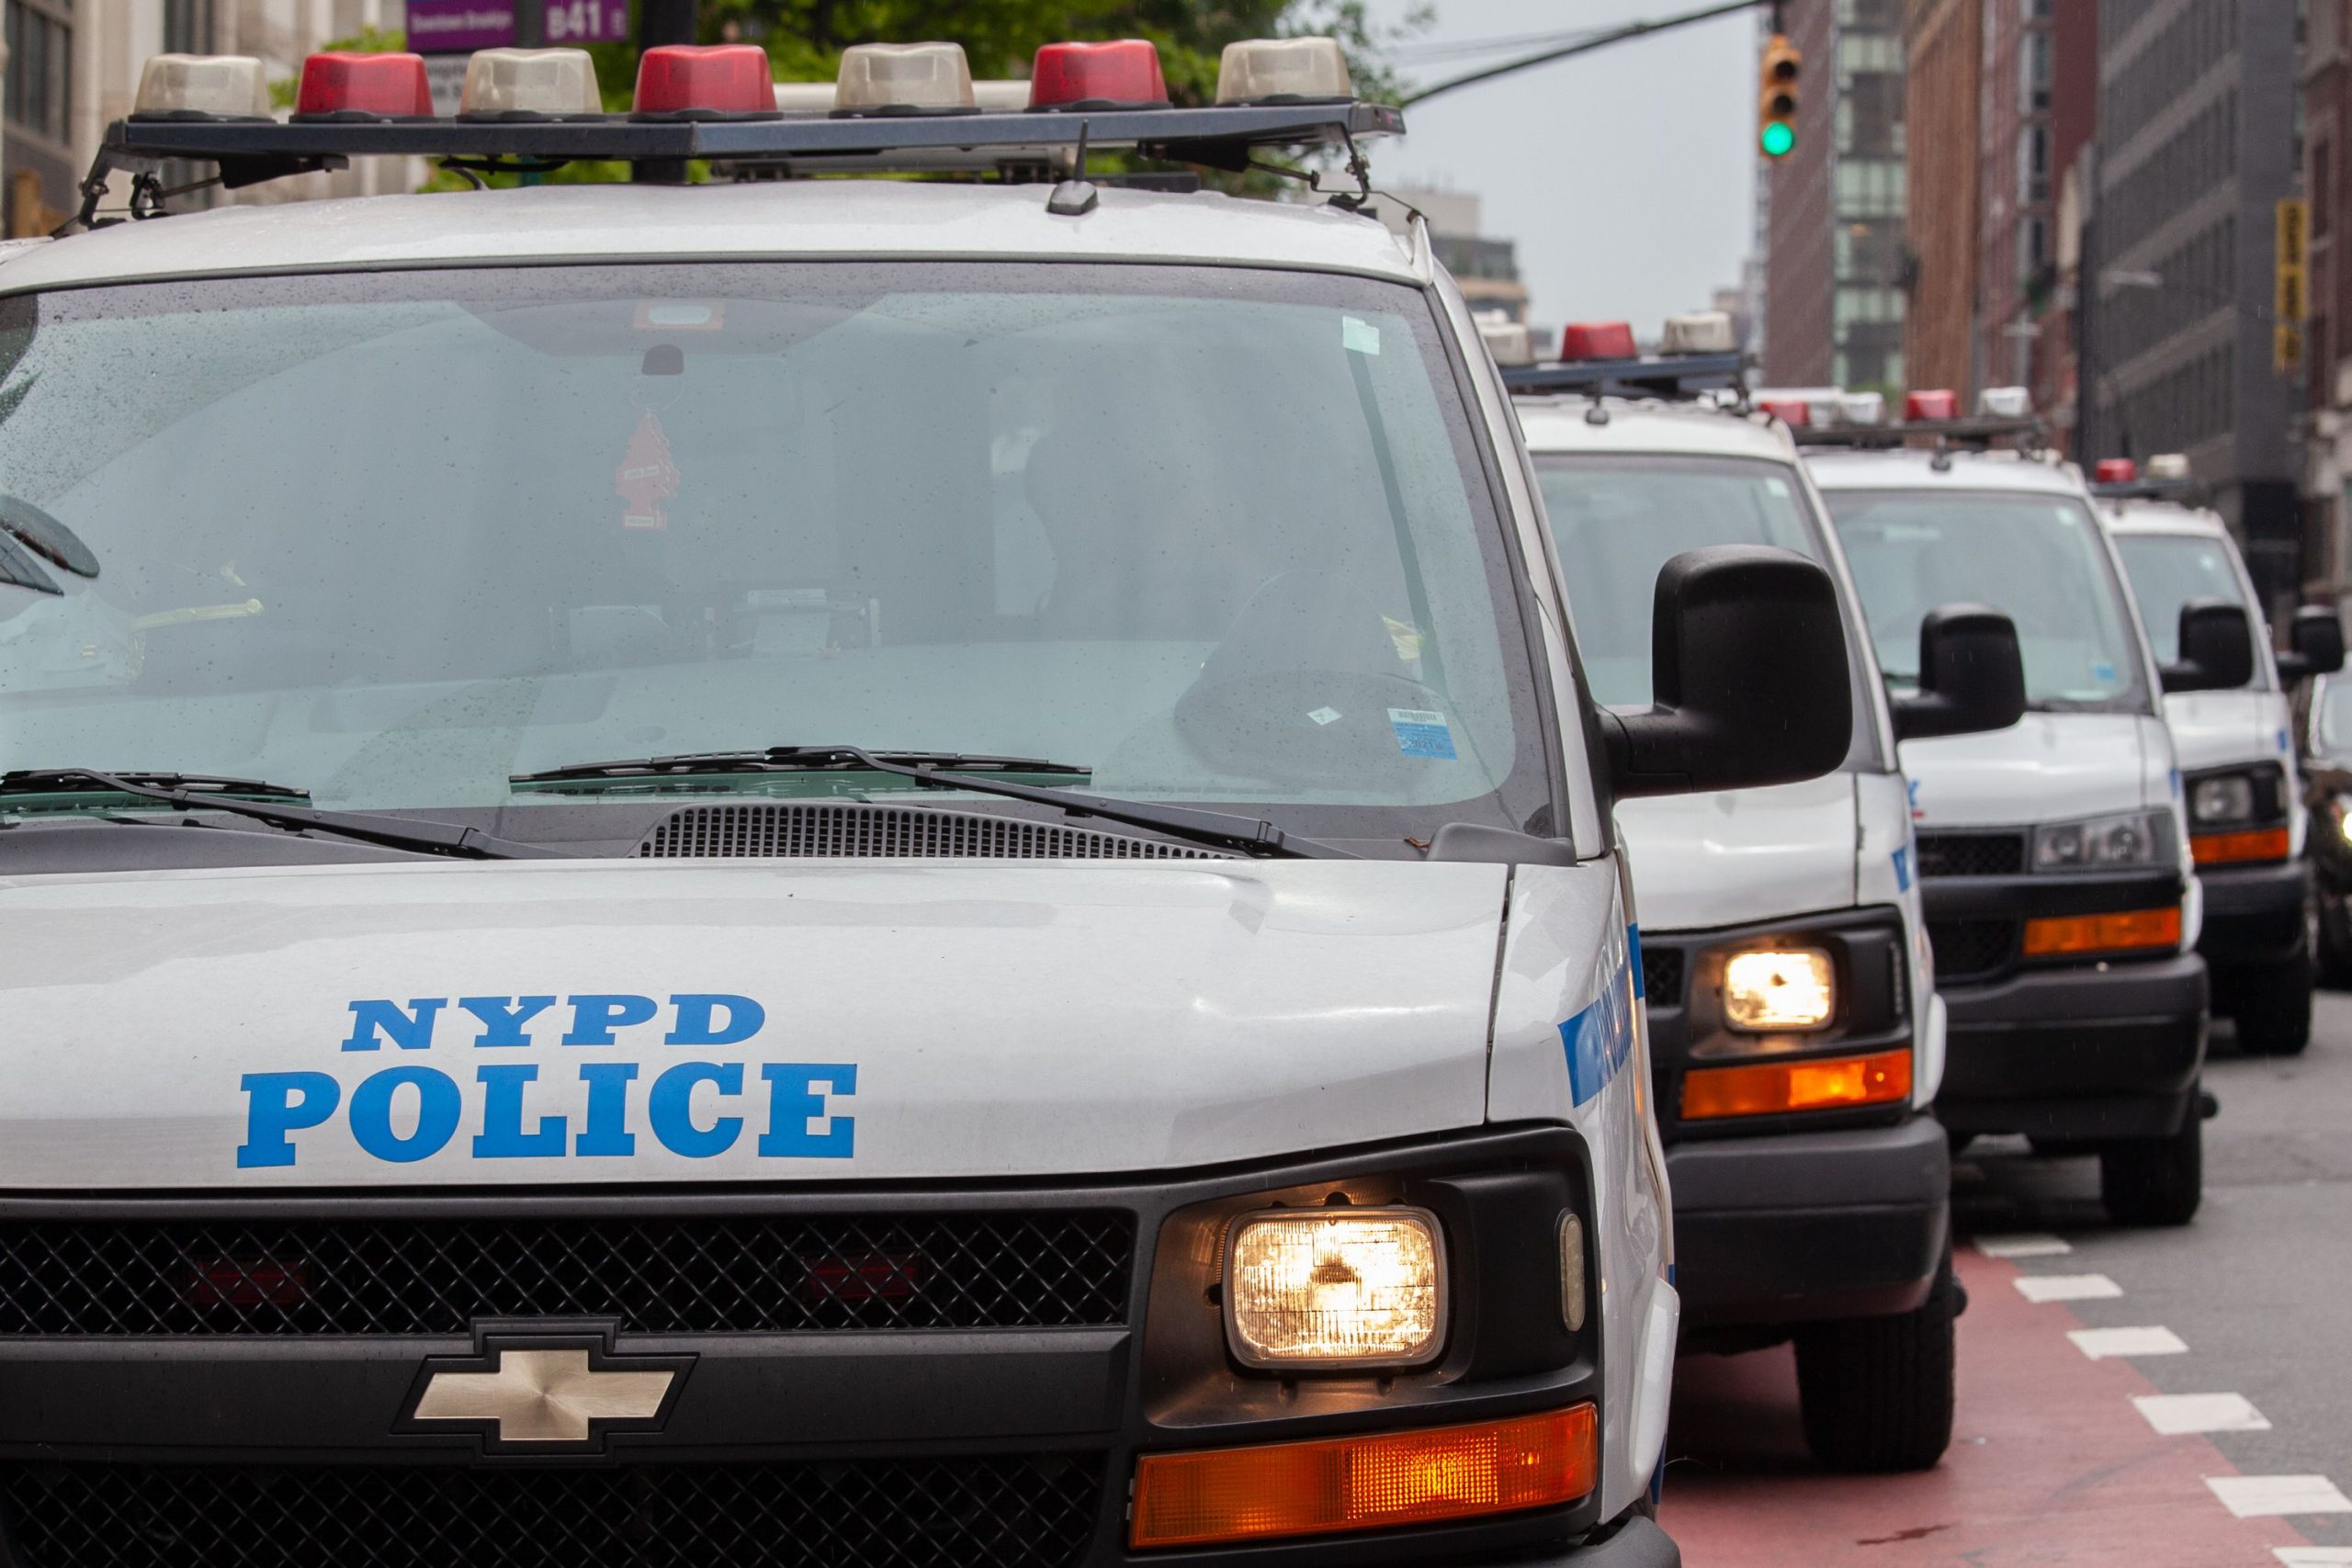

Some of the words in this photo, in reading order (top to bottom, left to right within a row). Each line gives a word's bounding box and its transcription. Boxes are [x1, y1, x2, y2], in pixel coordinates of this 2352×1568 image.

[547, 0, 602, 39] B41
[341, 994, 766, 1052] NYPD
[236, 1061, 858, 1168] POLICE
